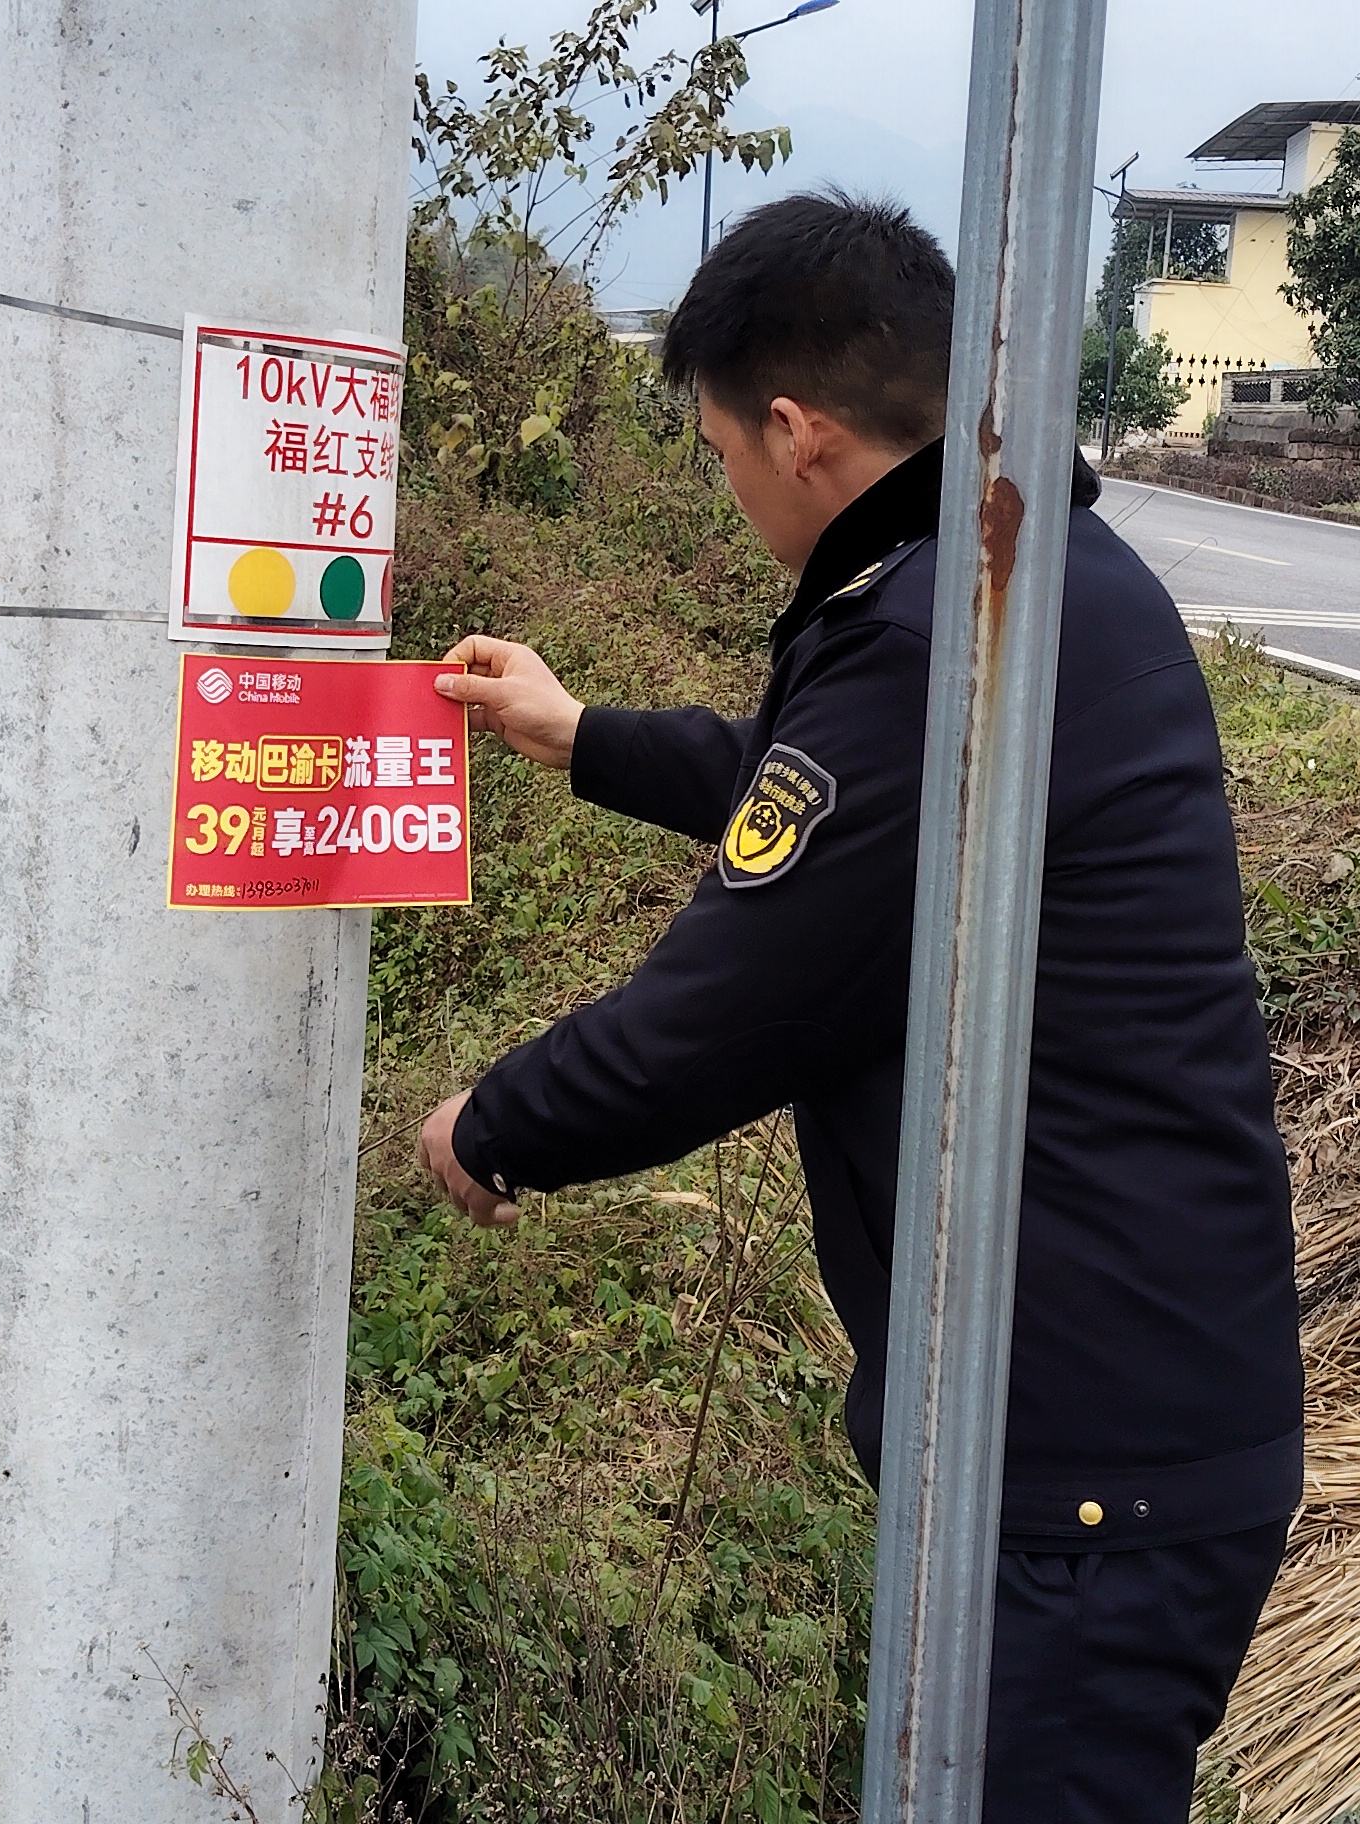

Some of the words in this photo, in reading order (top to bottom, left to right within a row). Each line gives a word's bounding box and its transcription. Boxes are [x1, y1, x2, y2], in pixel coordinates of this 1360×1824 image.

[264, 418, 395, 483] 福红支线
[313, 492, 374, 539] #6
[238, 671, 302, 692] 中国移动
[238, 690, 268, 703] China
[270, 692, 301, 704] Mobile
[185, 804, 251, 855] 39
[316, 804, 462, 855] 240GB
